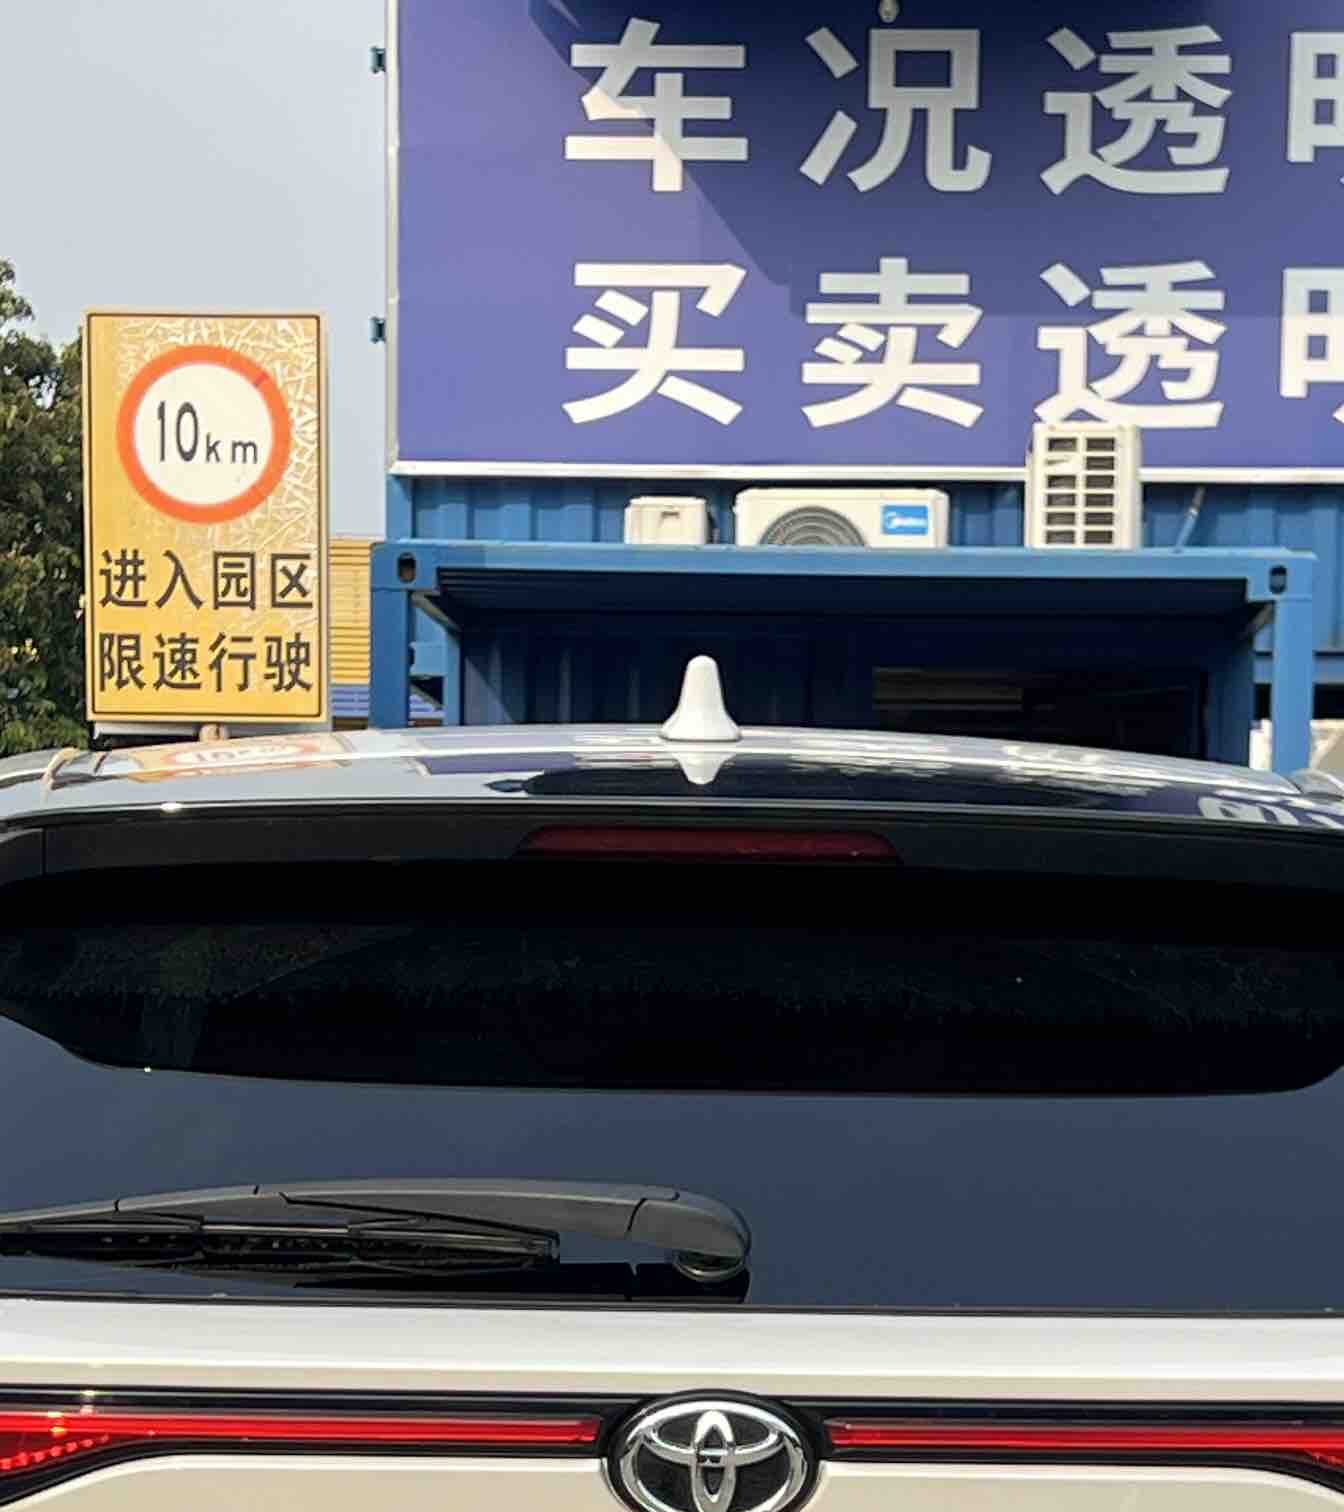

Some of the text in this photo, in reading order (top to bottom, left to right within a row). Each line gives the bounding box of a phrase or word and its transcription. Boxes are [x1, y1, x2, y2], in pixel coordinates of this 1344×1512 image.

[99, 548, 314, 611] 进入园区
[99, 631, 313, 693] 限速行驶
